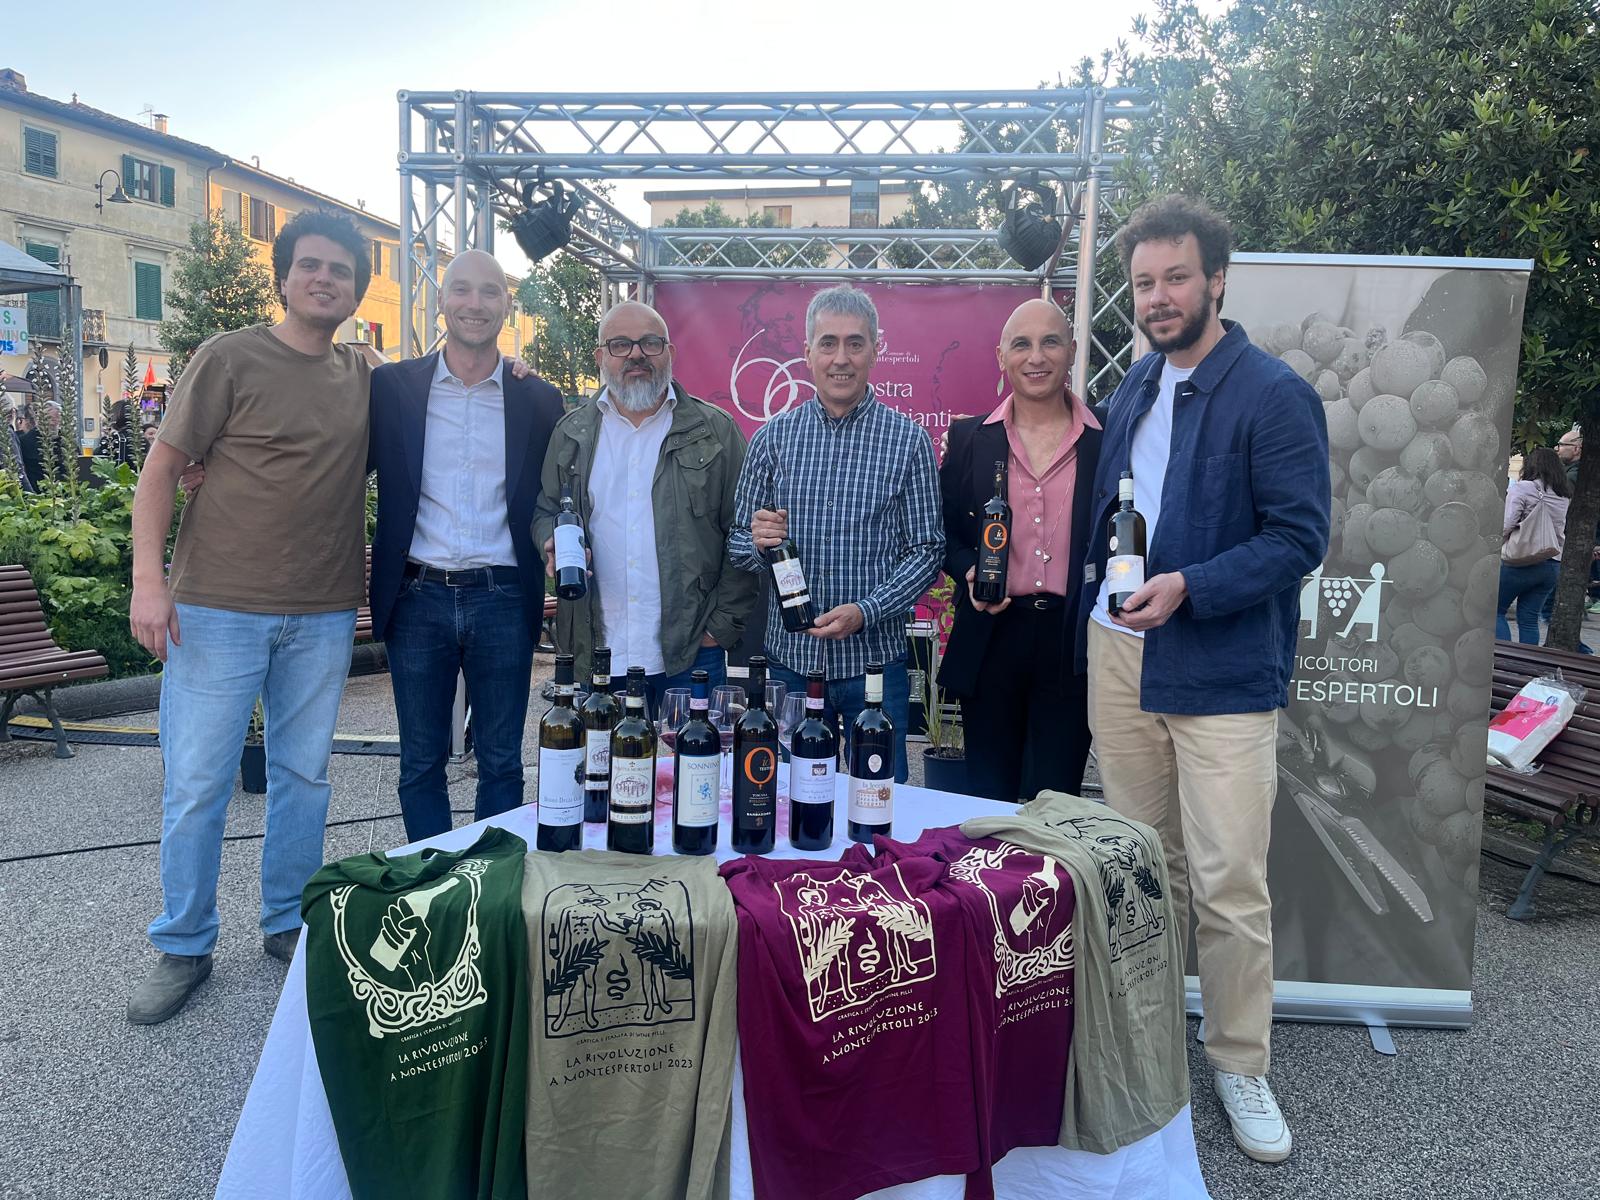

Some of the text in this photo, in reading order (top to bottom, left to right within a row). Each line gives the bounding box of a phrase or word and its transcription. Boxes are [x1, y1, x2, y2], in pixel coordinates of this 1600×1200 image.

[876, 353, 920, 365] ntespertoli
[889, 405, 952, 428] hianti
[1294, 655, 1378, 673] ICOLTORI
[1290, 679, 1438, 708] ESPERTOLI
[832, 1001, 924, 1043] LA RIVOLUZIONE
[398, 1031, 469, 1064] LA RIVOLUZIONE
[566, 1043, 675, 1069] LA RIVOLUZIONE
[822, 1055, 830, 1065] A
[390, 1072, 397, 1082] A
[549, 1058, 694, 1087] A MONTESPERTOLI 2023
